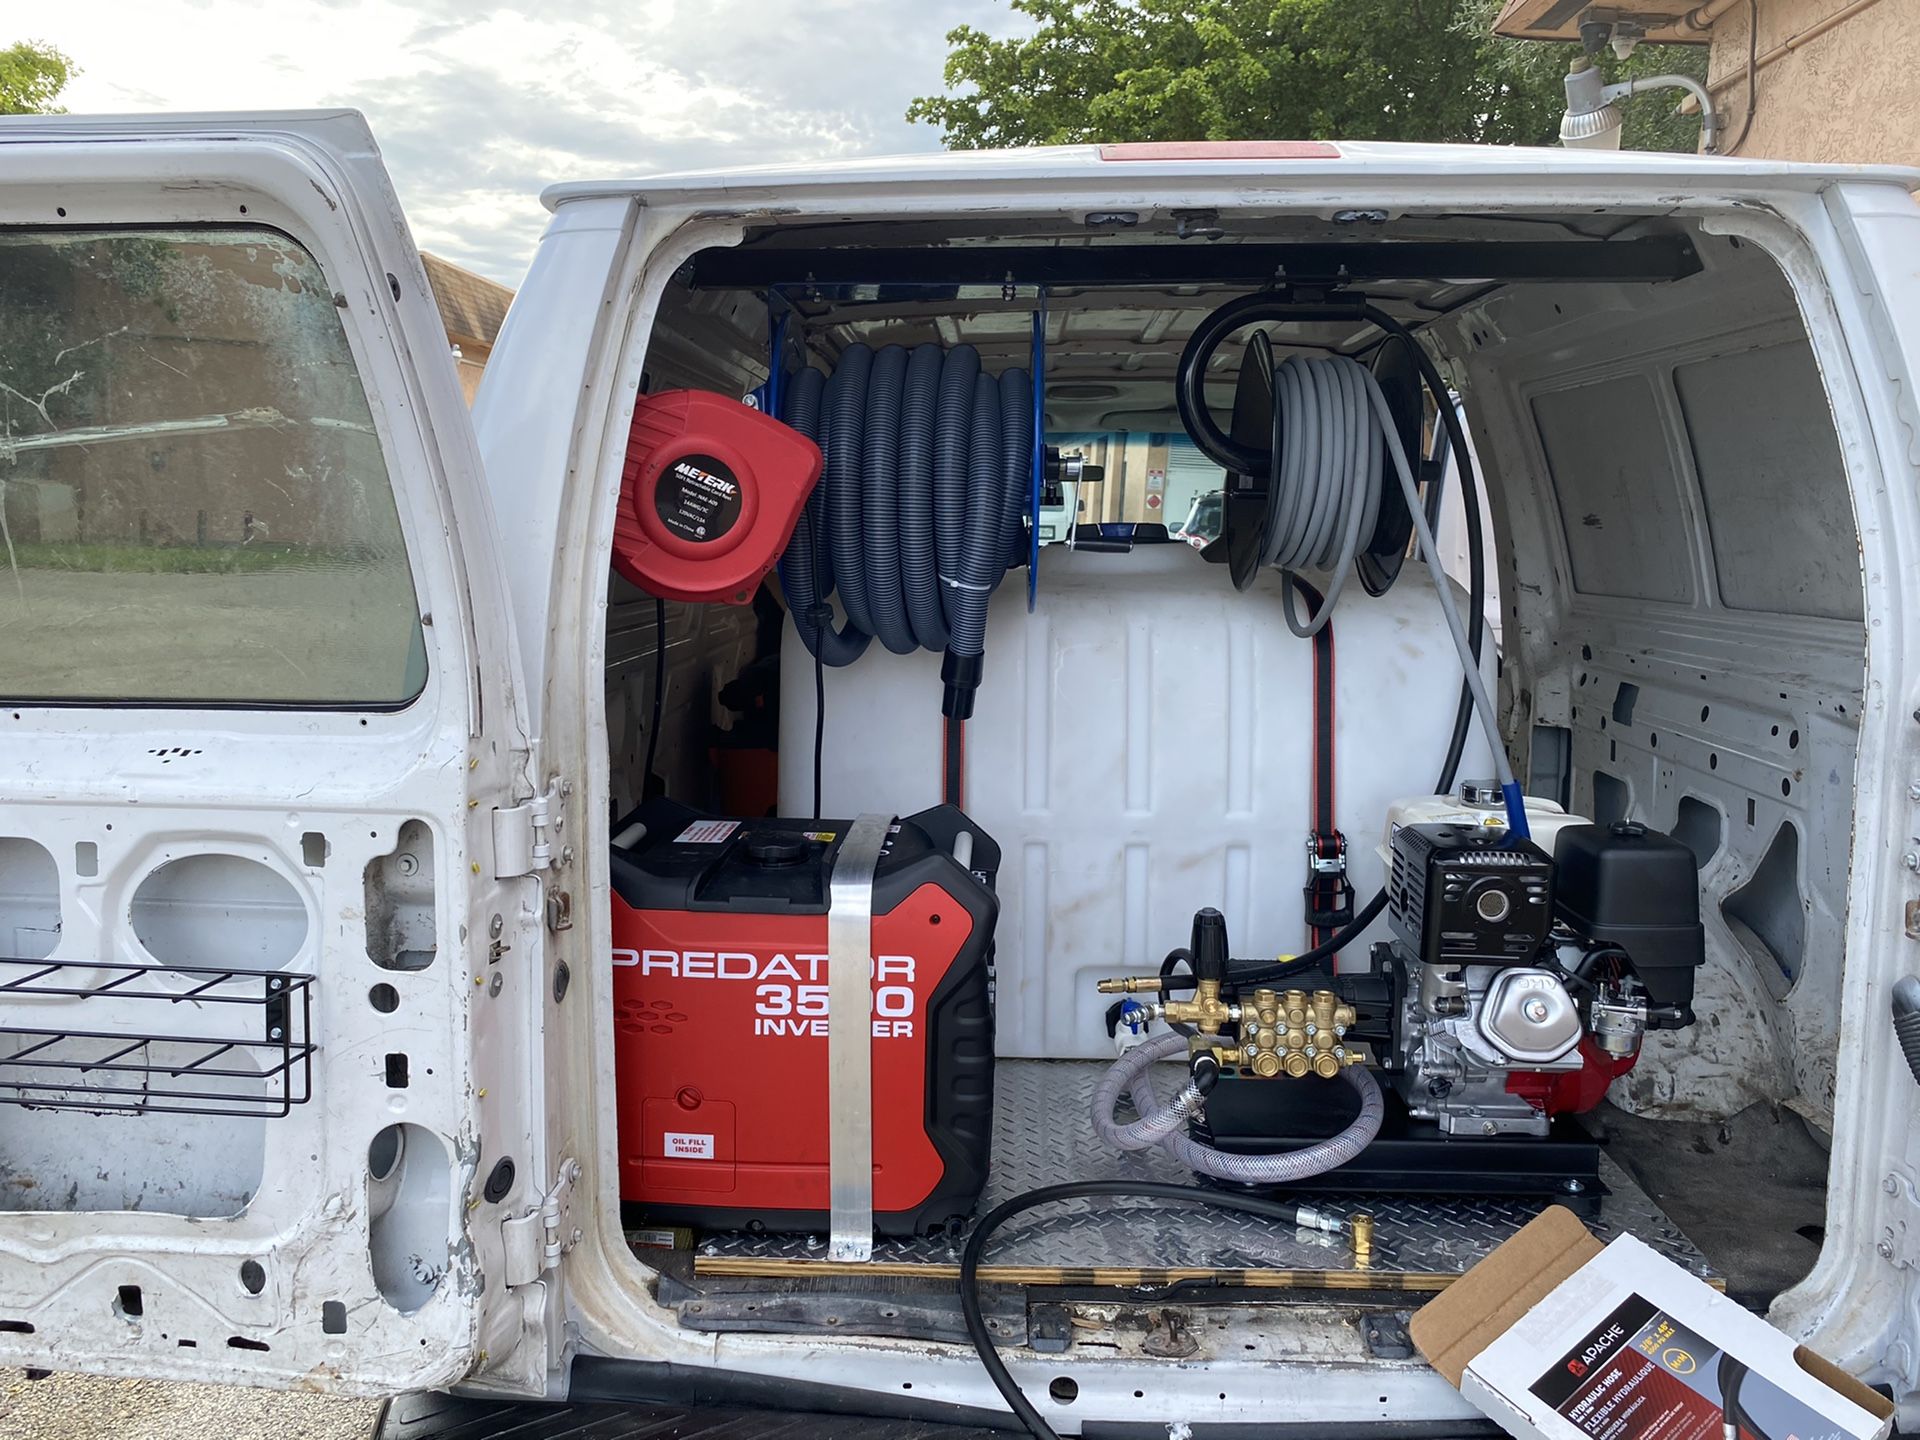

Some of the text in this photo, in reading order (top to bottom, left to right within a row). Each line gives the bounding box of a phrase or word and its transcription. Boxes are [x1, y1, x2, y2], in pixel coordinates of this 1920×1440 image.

[674, 463, 737, 495] METERK
[612, 949, 916, 982] PREDATR
[755, 984, 915, 1018] 350
[754, 1019, 913, 1038] INVEER
[675, 1146, 704, 1154] INSIDE
[1581, 1323, 1625, 1366] APACHE
[1568, 1368, 1623, 1420] HYDRAULIC HOSE
[1584, 1400, 1616, 1431] FLEXIBLE
[1611, 1361, 1656, 1404] HYDRAULIQUE
